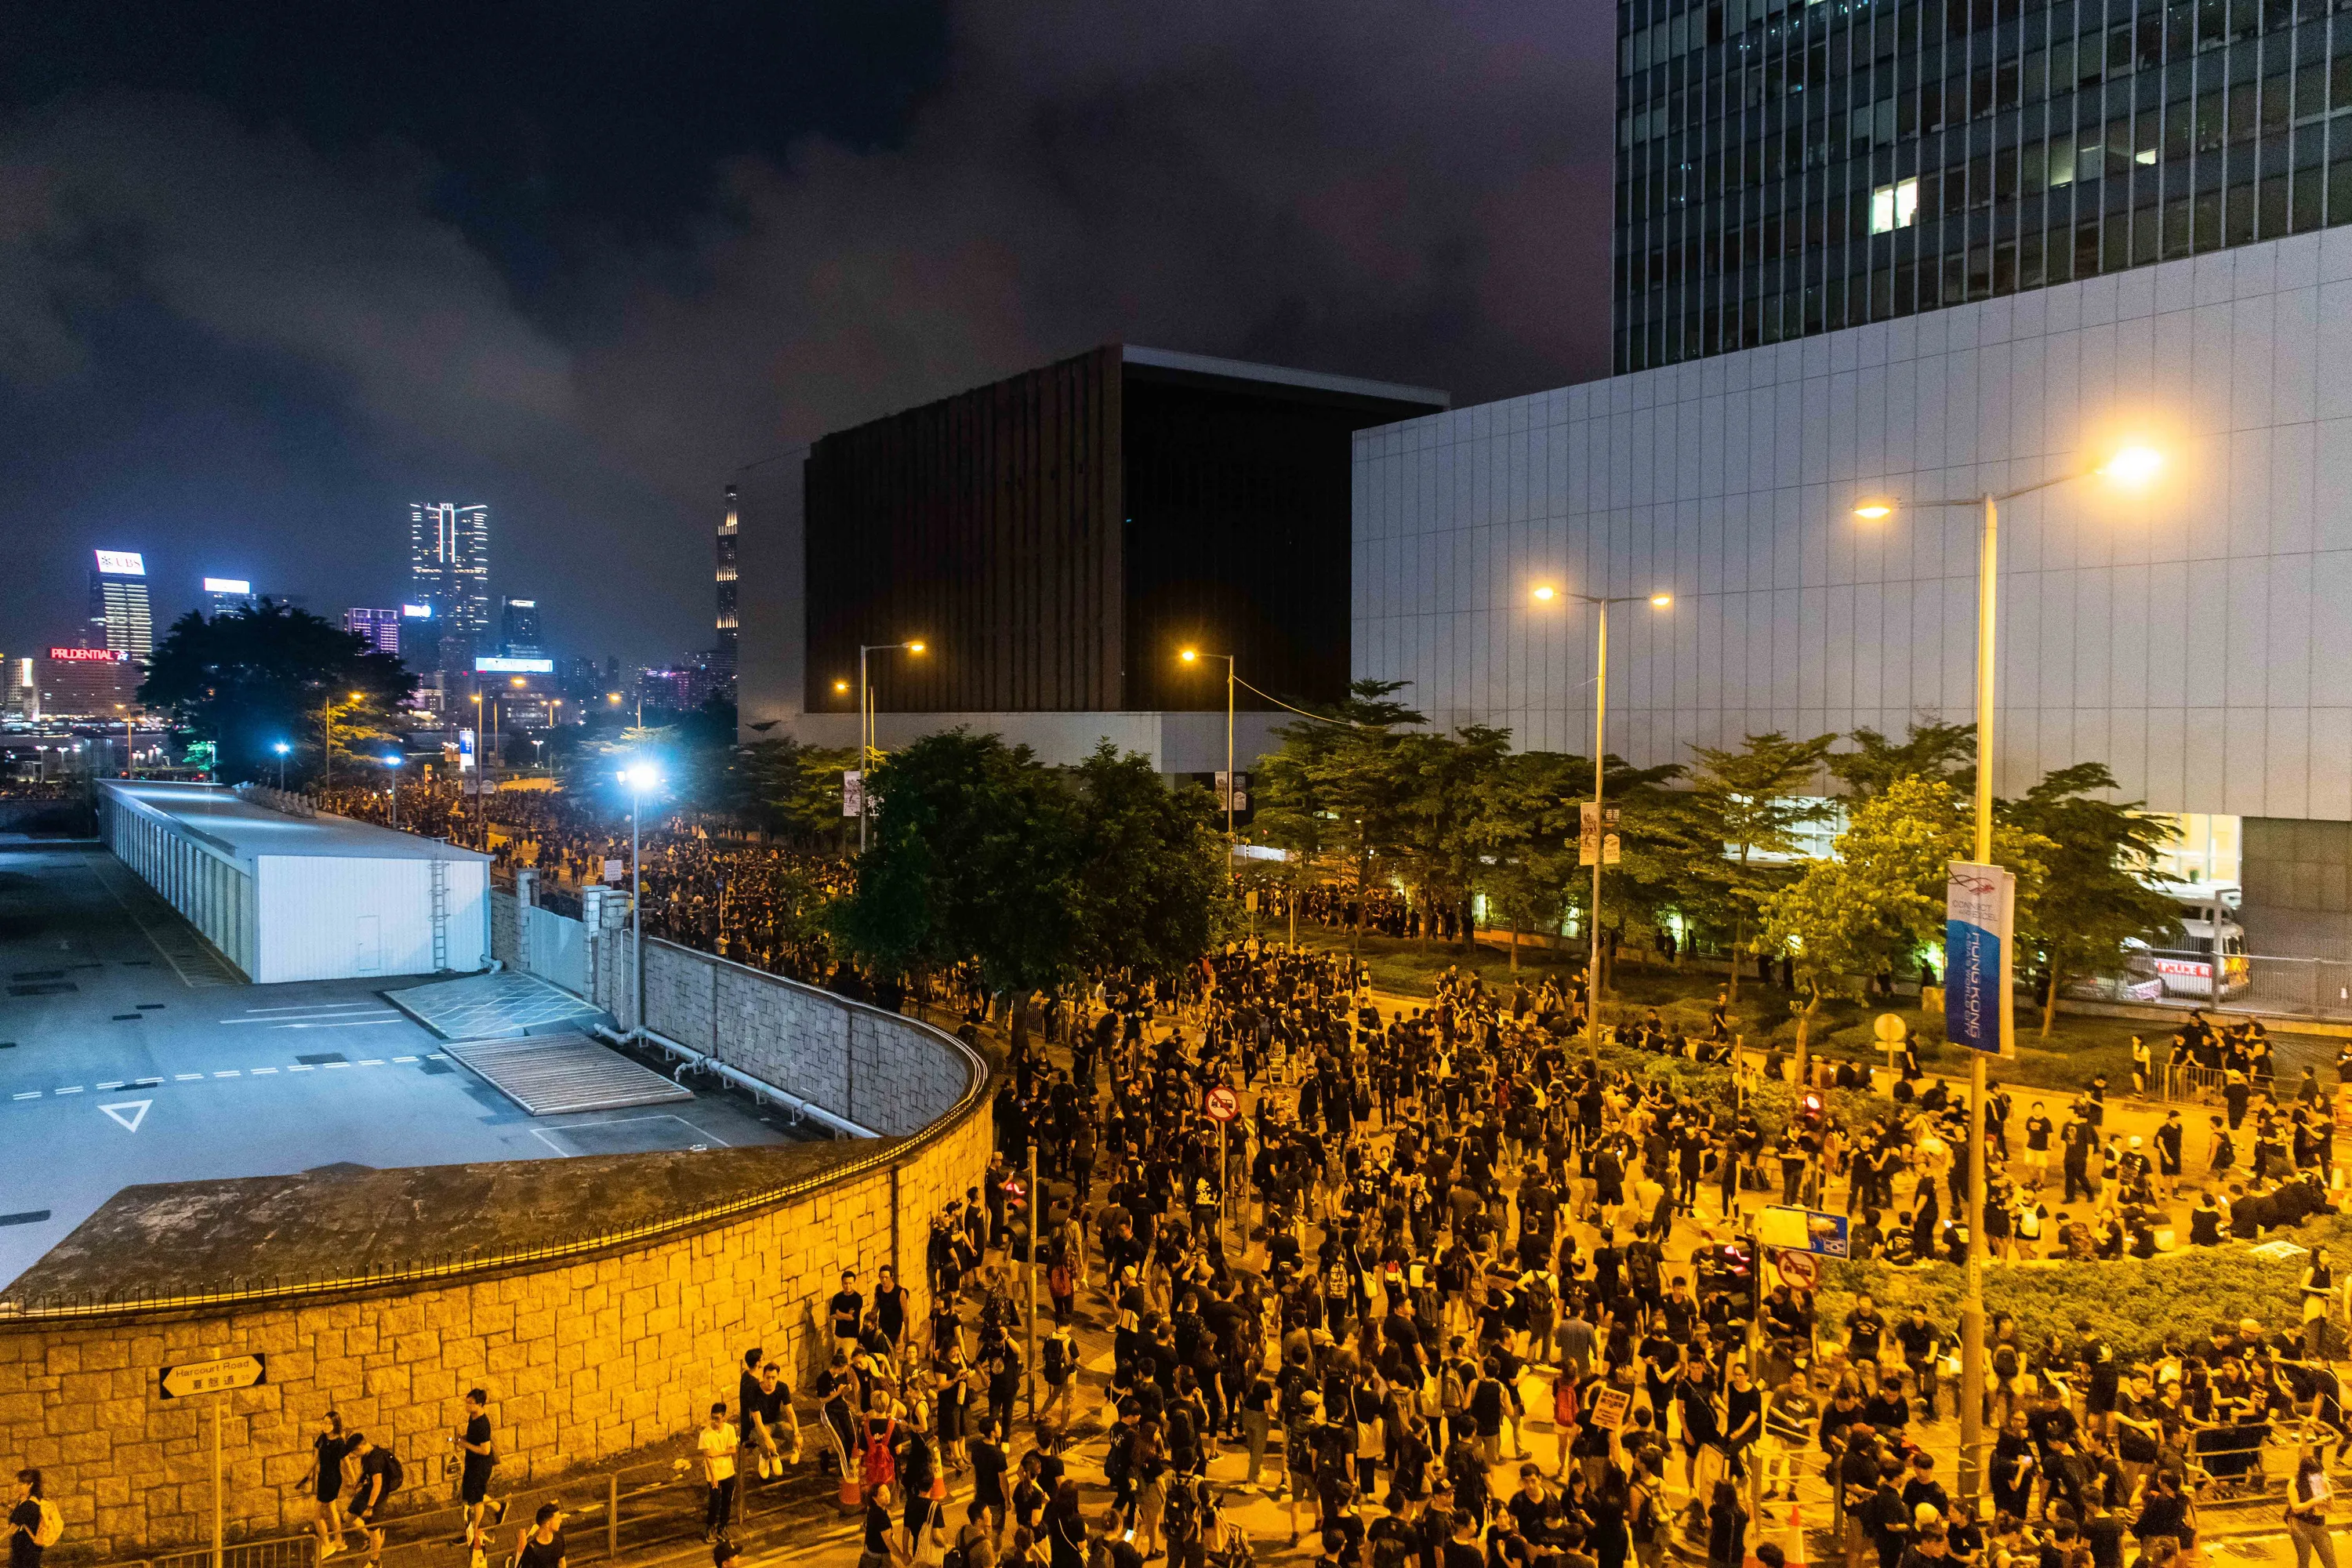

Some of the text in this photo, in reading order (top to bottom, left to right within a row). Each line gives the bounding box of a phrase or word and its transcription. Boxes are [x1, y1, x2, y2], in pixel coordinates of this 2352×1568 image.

[115, 557, 141, 568] UBS
[51, 648, 114, 660] PRUDENTIAL
[1970, 931, 1980, 1039] HONG KONG
[176, 1360, 249, 1377] Harcourt Road
